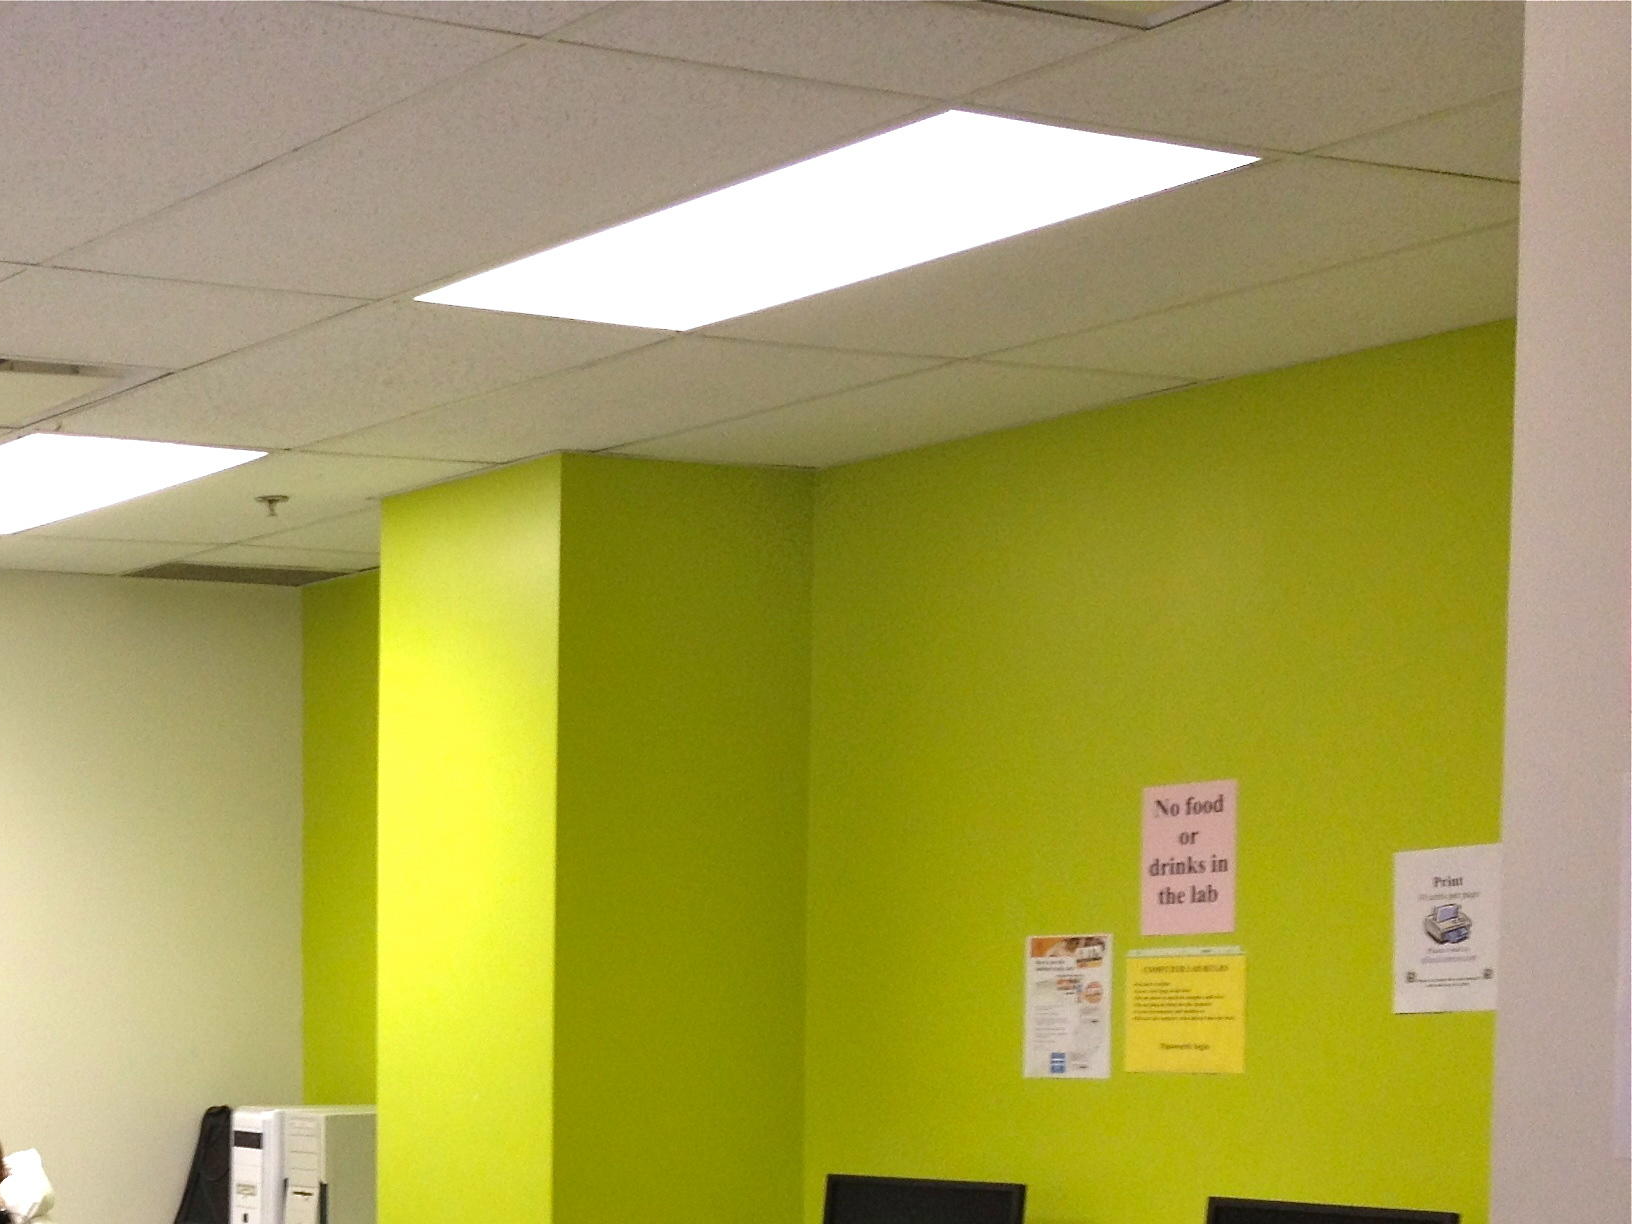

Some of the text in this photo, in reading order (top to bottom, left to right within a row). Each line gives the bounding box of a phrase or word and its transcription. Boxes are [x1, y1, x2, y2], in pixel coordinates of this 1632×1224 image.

[1155, 793, 1224, 817] No food
[1178, 831, 1199, 845] or
[1149, 854, 1228, 876] drinks in
[1433, 876, 1464, 887] Print
[1158, 884, 1218, 904] the lab
